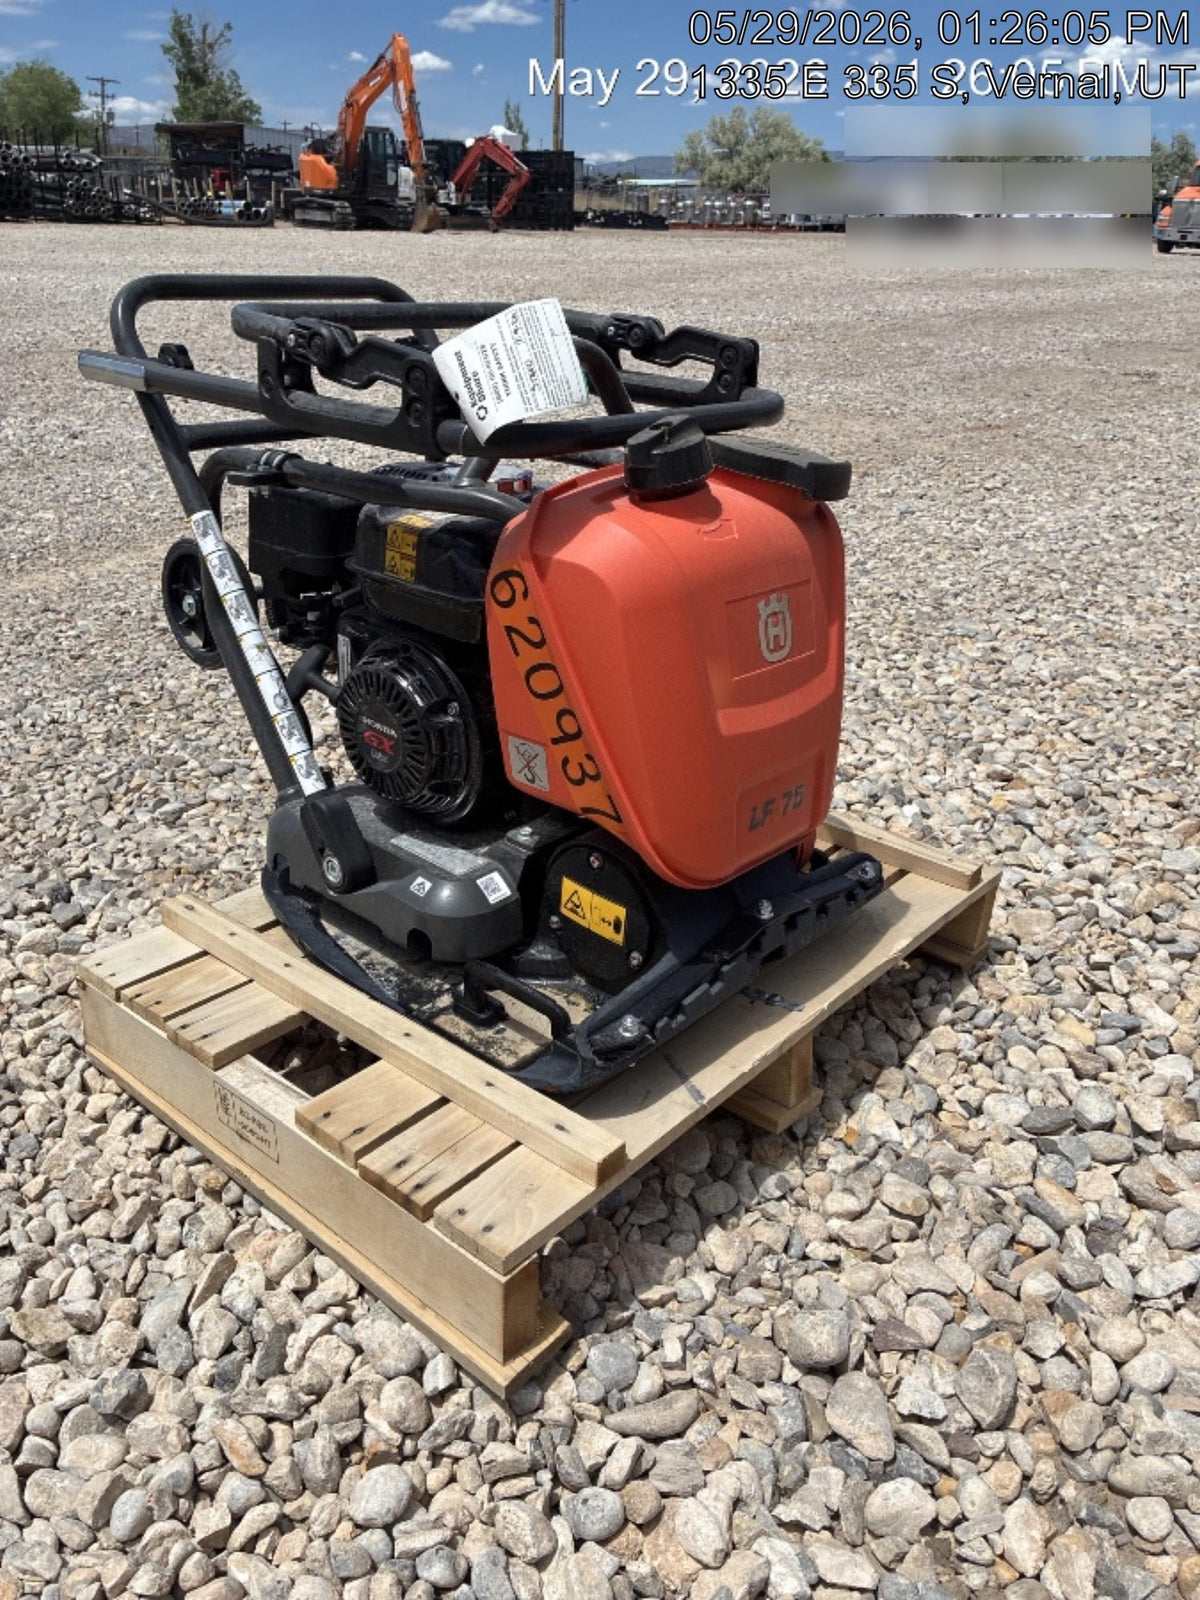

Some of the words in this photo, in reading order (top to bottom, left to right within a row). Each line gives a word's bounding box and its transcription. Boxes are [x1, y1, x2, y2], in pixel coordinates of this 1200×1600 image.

[489, 568, 624, 826] 620937
[748, 797, 776, 832] LF
[781, 783, 805, 816] 75
